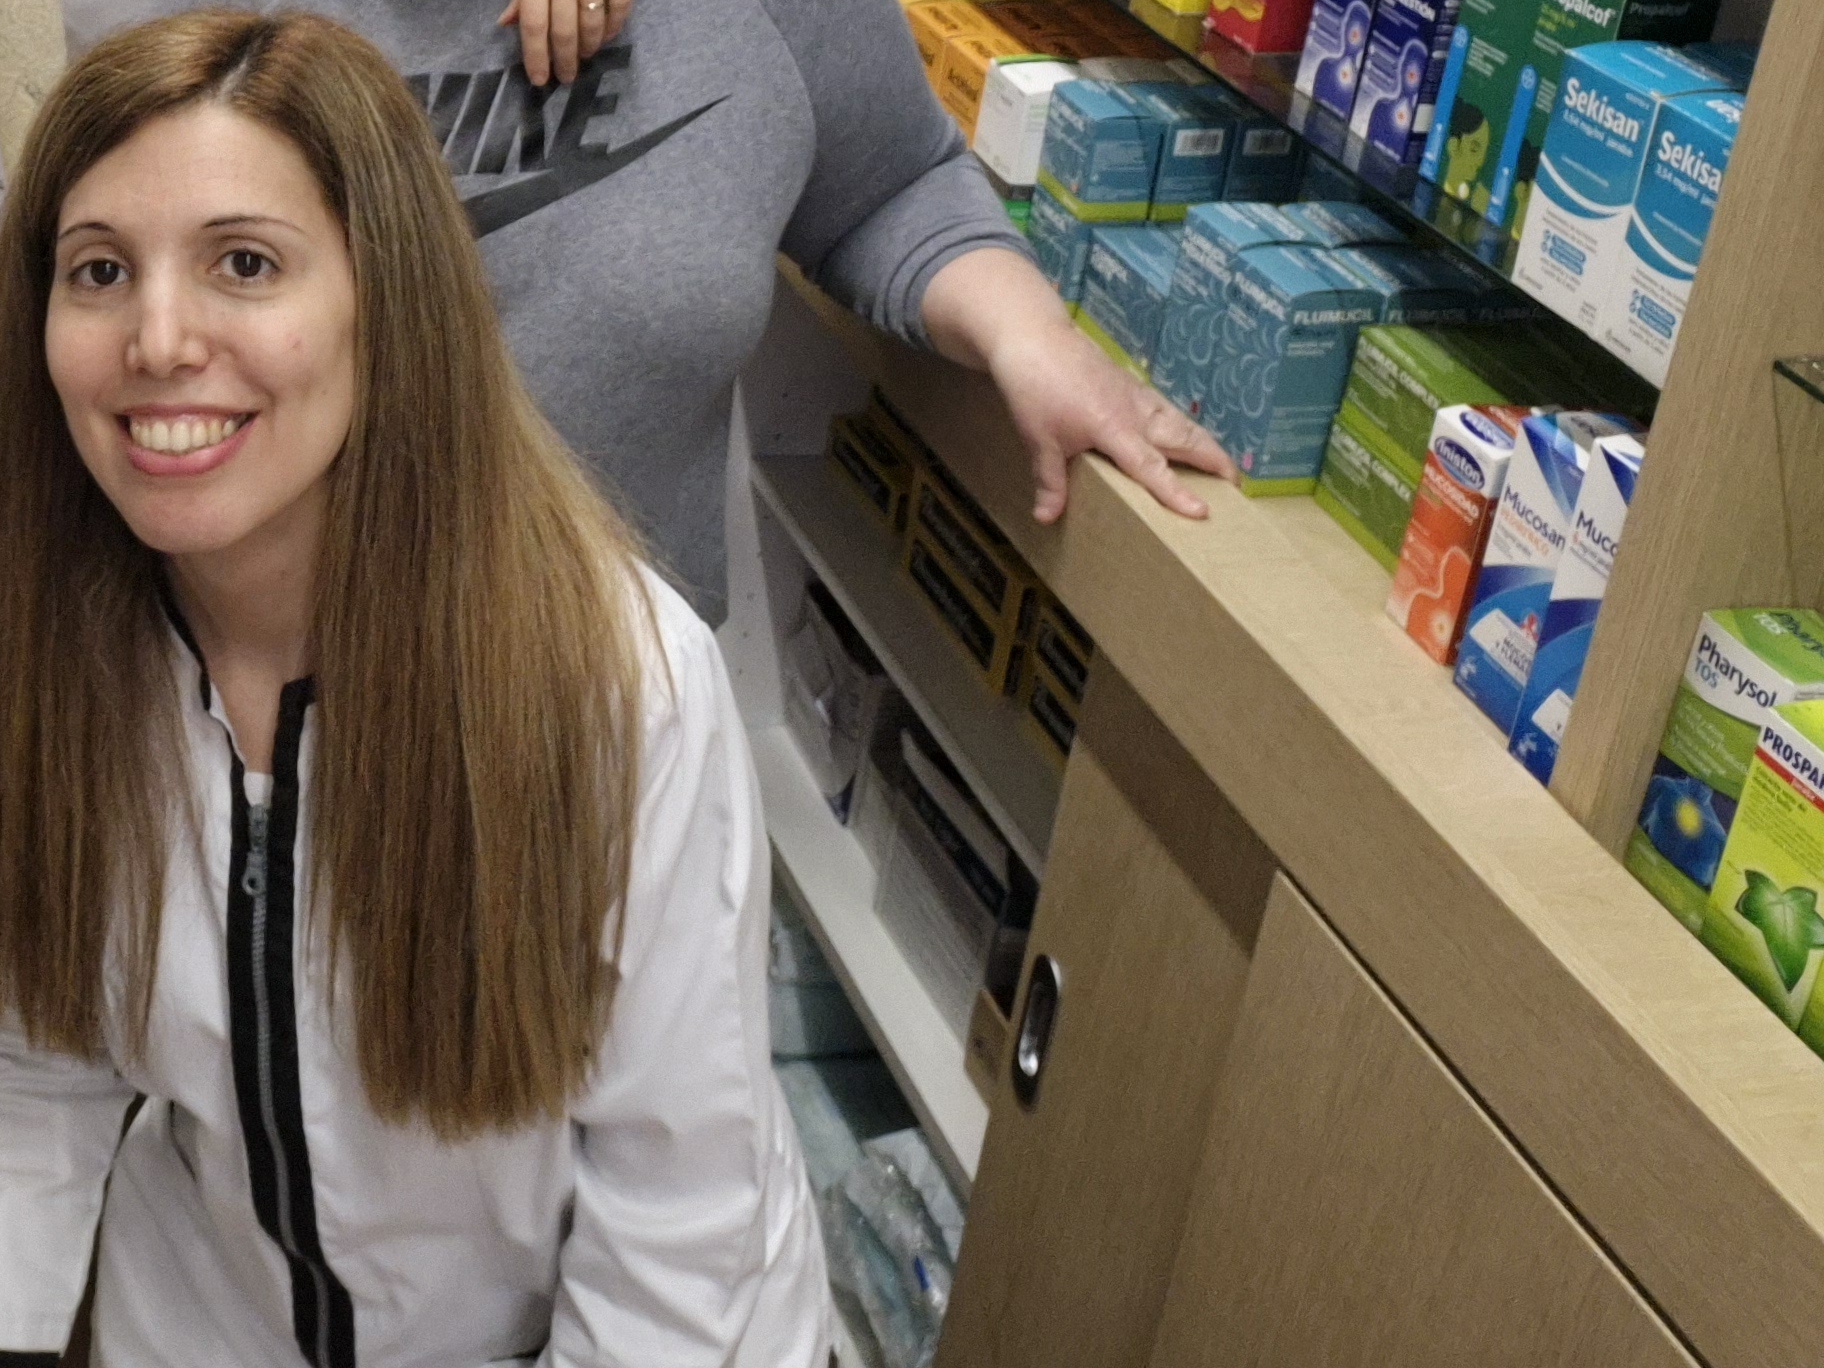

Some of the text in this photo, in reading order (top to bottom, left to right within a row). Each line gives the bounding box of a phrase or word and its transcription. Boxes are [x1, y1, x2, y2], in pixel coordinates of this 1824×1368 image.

[404, 45, 633, 174] NIKE
[1564, 78, 1641, 143] Sekisan
[1658, 131, 1723, 194] Sekisa
[1437, 440, 1483, 488] Iniston
[1504, 483, 1567, 551] Mucosan
[1576, 510, 1618, 558] Muco
[1693, 656, 1720, 689] TOS
[1697, 633, 1779, 709] Pharysol
